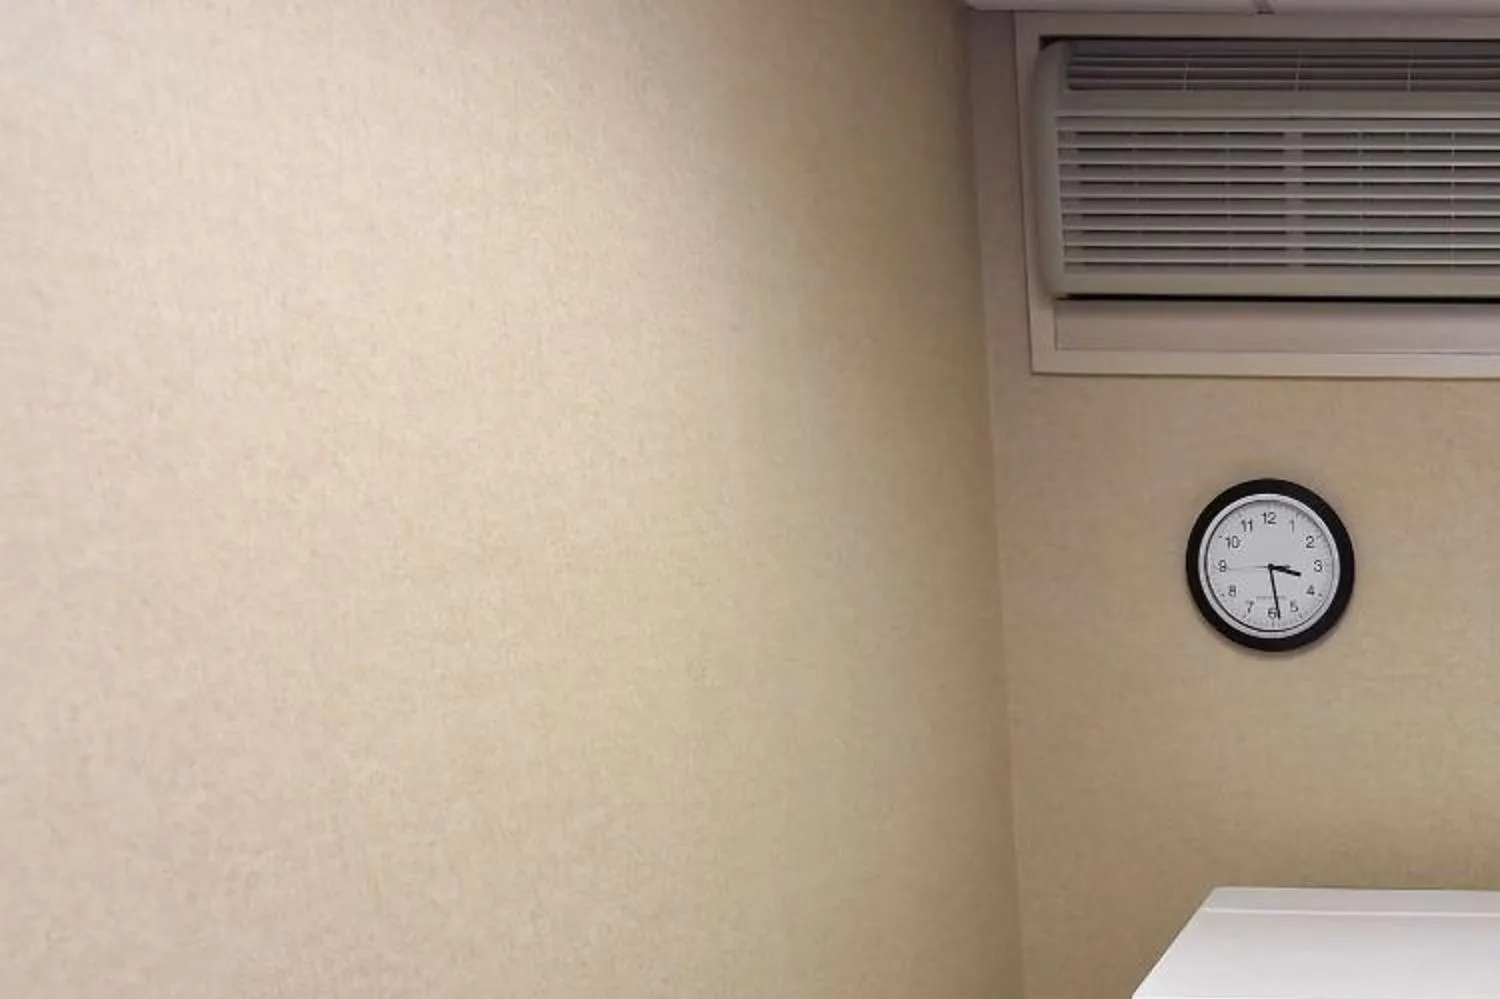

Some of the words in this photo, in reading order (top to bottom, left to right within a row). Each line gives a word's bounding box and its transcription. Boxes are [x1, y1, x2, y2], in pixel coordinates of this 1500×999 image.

[1261, 511, 1278, 525] 12
[1241, 520, 1253, 533] 11
[1225, 535, 1241, 549] 10
[1305, 535, 1316, 549] 2
[1218, 559, 1227, 573] 9
[1313, 559, 1323, 573] 3
[1228, 584, 1237, 598] 8
[1306, 584, 1315, 596] 4
[1246, 600, 1255, 613] 7
[1267, 607, 1277, 620] 6
[1290, 601, 1299, 613] 5
